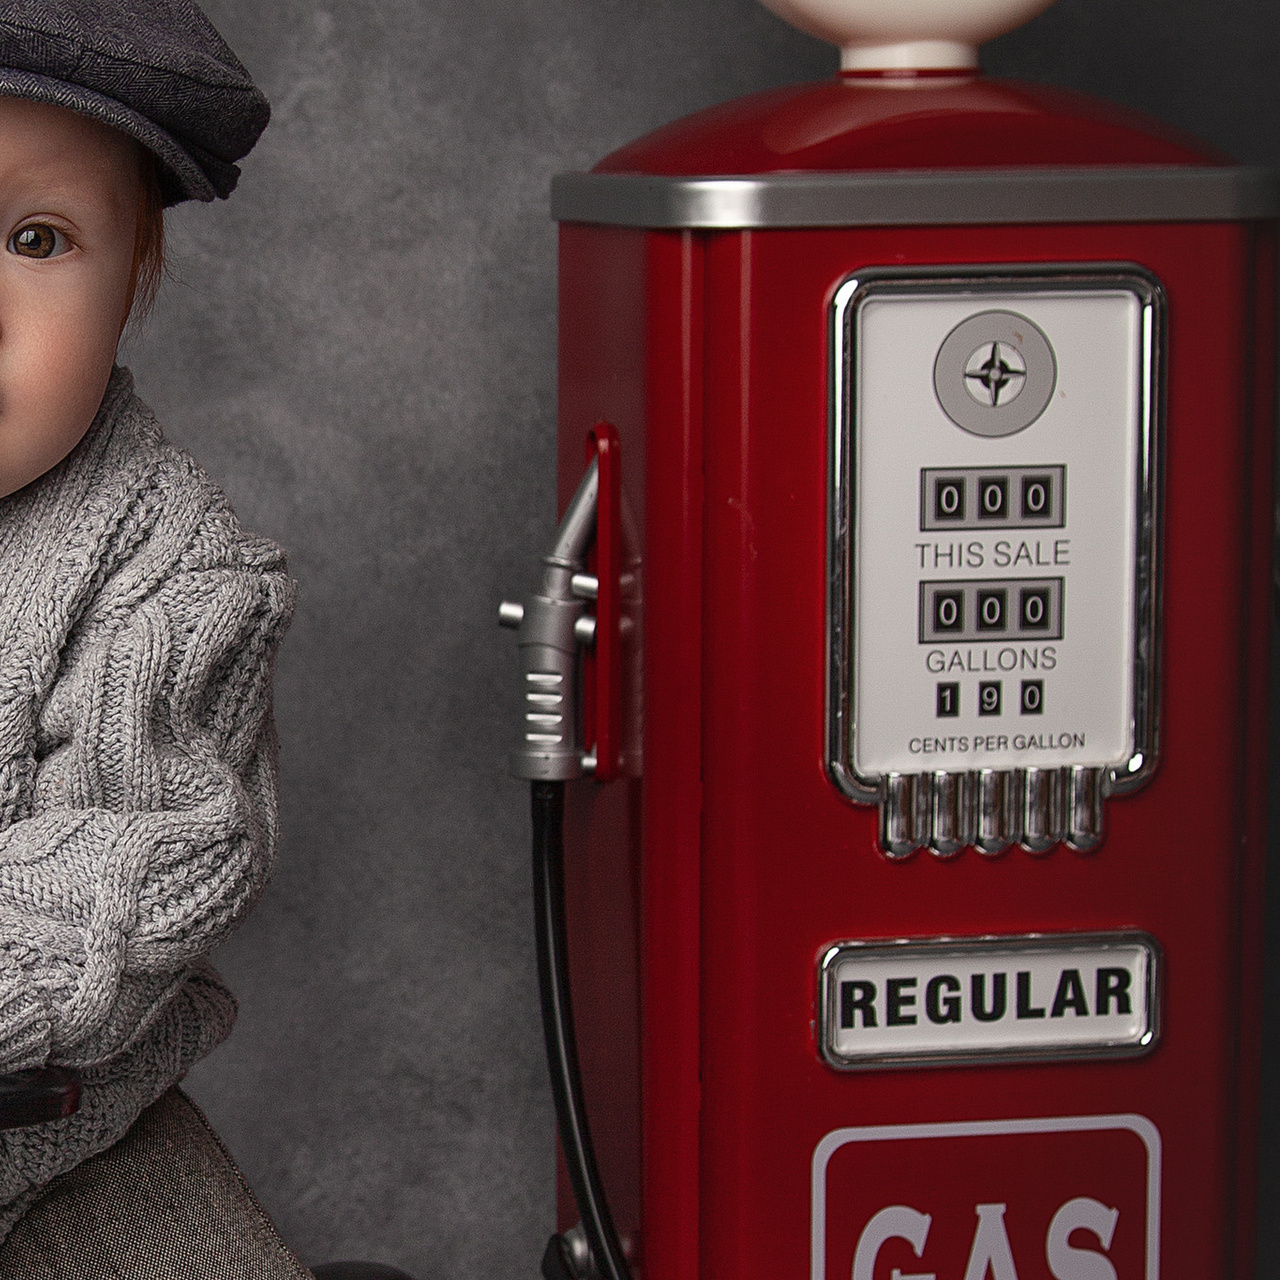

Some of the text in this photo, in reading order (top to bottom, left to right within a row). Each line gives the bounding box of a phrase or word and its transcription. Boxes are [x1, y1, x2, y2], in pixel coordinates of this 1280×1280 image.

[915, 539, 1071, 570] THIS SALE
[926, 646, 1057, 674] GALLONS
[909, 732, 1086, 754] CENTS PER GALLON
[840, 966, 1133, 1030] REGULAR
